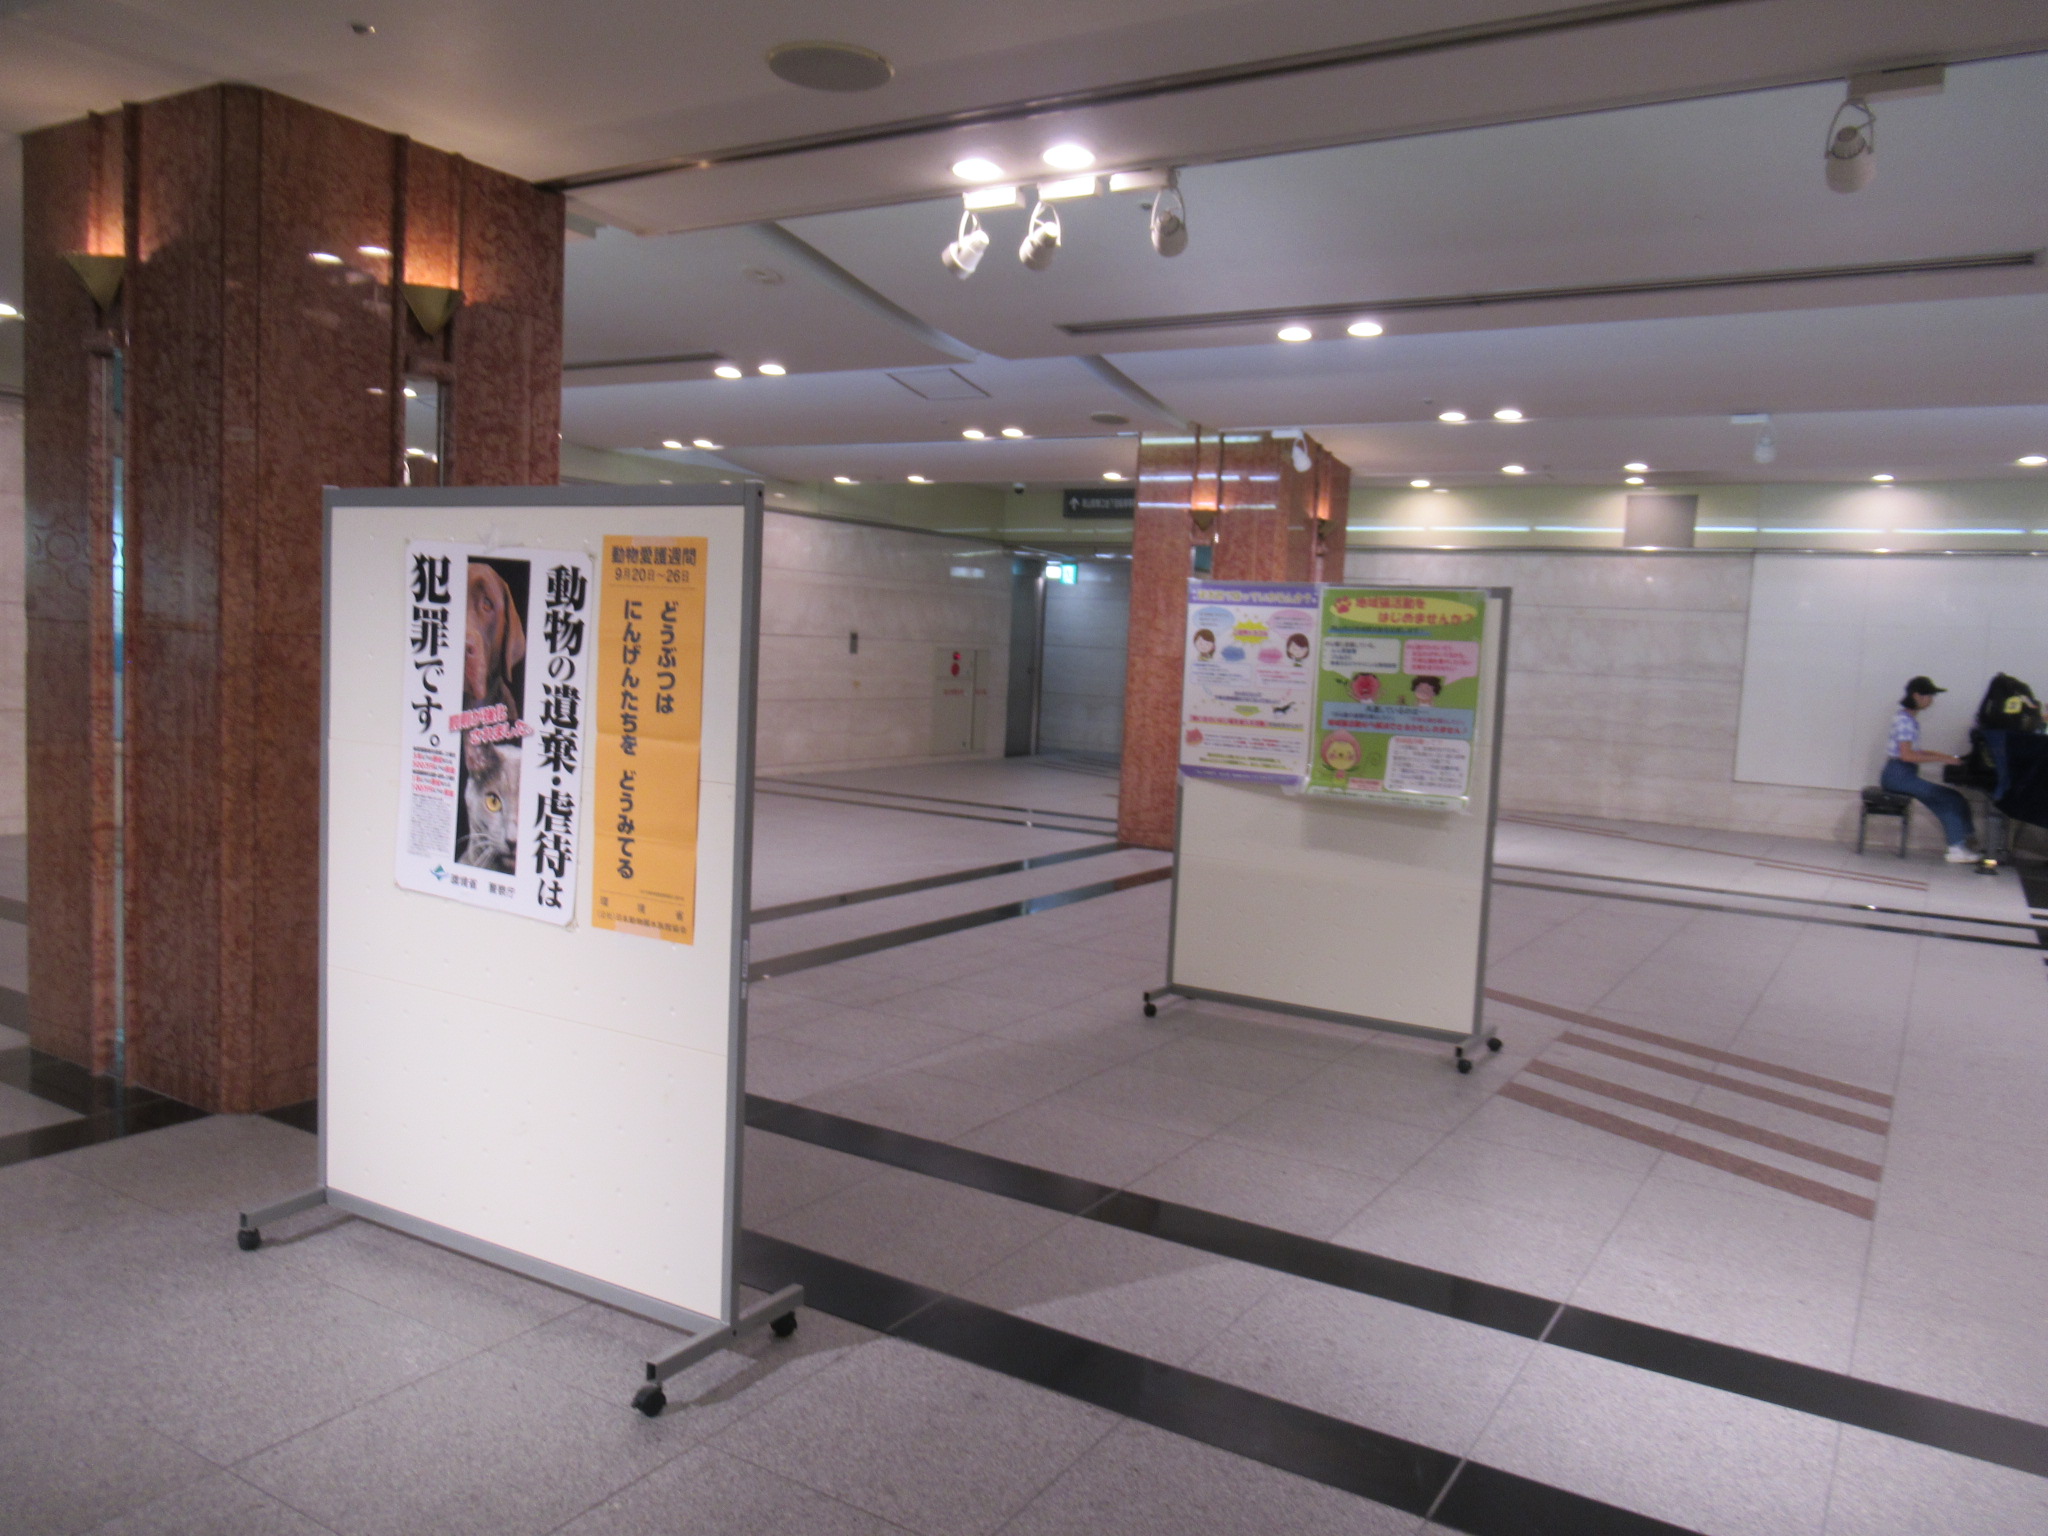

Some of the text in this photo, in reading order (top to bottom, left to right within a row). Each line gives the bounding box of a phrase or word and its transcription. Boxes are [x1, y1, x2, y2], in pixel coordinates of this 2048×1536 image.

[410, 552, 452, 747] 犯罪です。
[611, 545, 697, 566] 動物愛護週間
[534, 564, 588, 909] 動物の遺棄・虐待は
[617, 600, 644, 880] にんげんたちを どうみてる
[656, 600, 678, 714] どうぶつは
